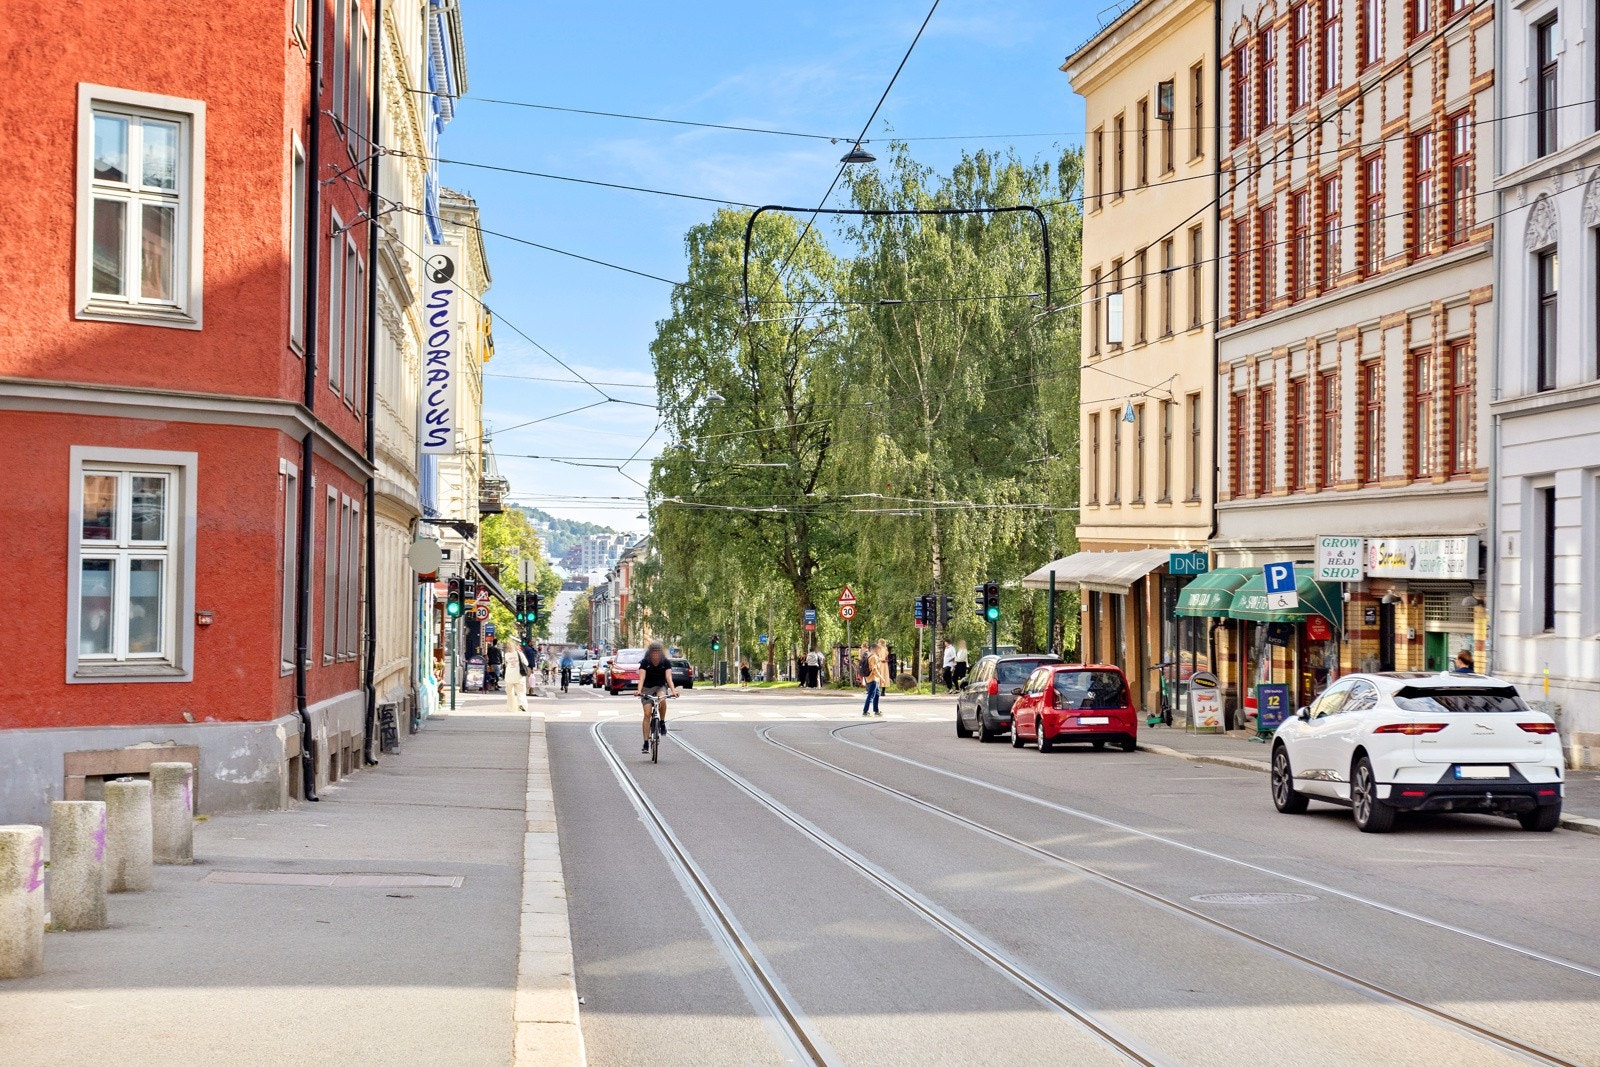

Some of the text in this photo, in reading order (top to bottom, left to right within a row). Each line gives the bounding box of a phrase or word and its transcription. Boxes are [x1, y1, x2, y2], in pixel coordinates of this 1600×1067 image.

[1322, 538, 1360, 548] GROW
[1175, 554, 1205, 574] DNB
[1328, 558, 1355, 566] HEAD
[1271, 566, 1288, 589] P
[1322, 567, 1359, 578] SHOP
[477, 609, 487, 617] 30
[843, 608, 853, 616] 30
[1268, 695, 1280, 706] 12
